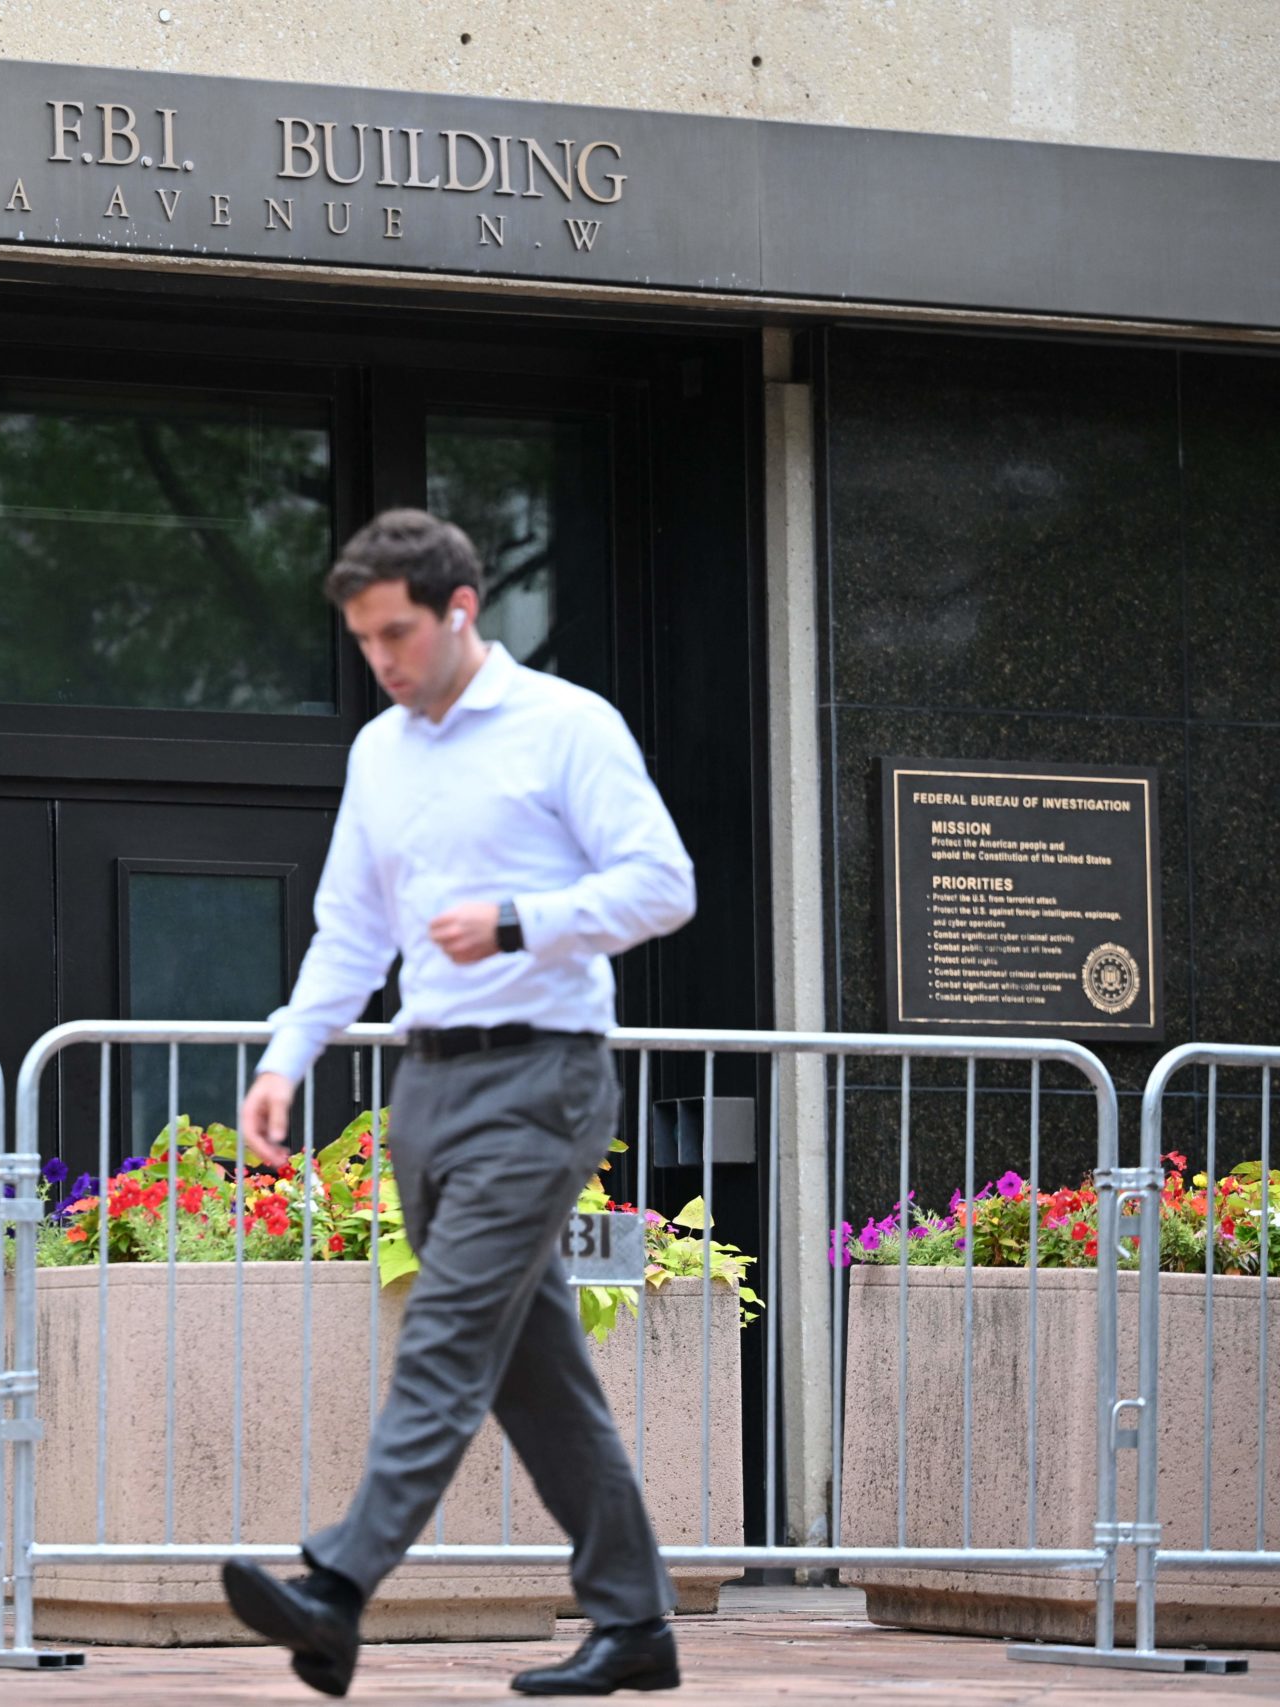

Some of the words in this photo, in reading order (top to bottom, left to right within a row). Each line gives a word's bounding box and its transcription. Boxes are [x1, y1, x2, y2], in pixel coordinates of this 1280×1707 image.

[46, 100, 194, 171] F.B.I.
[276, 116, 628, 203] BUILDING
[104, 184, 403, 238] AVENUE
[913, 792, 967, 806] FEDERAL
[971, 795, 1019, 808] BUREAU
[1023, 796, 1039, 808] OF
[1042, 798, 1131, 812] INVESTIGATION
[931, 820, 992, 835] MISSION
[931, 836, 962, 848] Protect
[964, 838, 977, 848] the
[979, 838, 1018, 850] American
[1019, 841, 1047, 852] people
[1049, 841, 1065, 851] and
[931, 850, 960, 862] uphold
[962, 850, 976, 860] the
[978, 851, 1029, 862] Constitution
[1031, 852, 1041, 863] of
[1042, 853, 1055, 863] the
[1057, 854, 1084, 864] United
[1085, 855, 1112, 865] States
[932, 876, 1014, 891] PRIORITIES
[932, 893, 958, 902] Protect
[959, 894, 971, 902] the
[972, 894, 986, 903] U.S.
[988, 895, 1005, 903] from
[1006, 895, 1035, 905] terrorist
[1036, 896, 1057, 905] attack
[932, 905, 958, 914] Protect
[959, 906, 971, 914] the
[972, 906, 986, 915] U.S.
[988, 908, 1014, 918] against
[1015, 908, 1040, 919] foreign
[933, 918, 946, 927] and
[948, 918, 967, 928] cyber
[968, 920, 1006, 929] operations
[933, 930, 960, 940] Combat
[961, 931, 998, 941] significant
[1000, 932, 1018, 942] cyber
[1020, 933, 1048, 942] criminal
[1049, 934, 1074, 944] activity
[933, 943, 960, 952] Combat
[933, 955, 959, 964] Protect
[960, 956, 976, 965] civil
[934, 967, 960, 976] Combat
[1009, 970, 1036, 978] criminal
[934, 980, 961, 989] Combat
[962, 981, 999, 991] significant
[1041, 983, 1062, 992] crime
[935, 992, 961, 1001] Combat
[963, 993, 999, 1003] significant
[560, 1213, 611, 1259] BI
